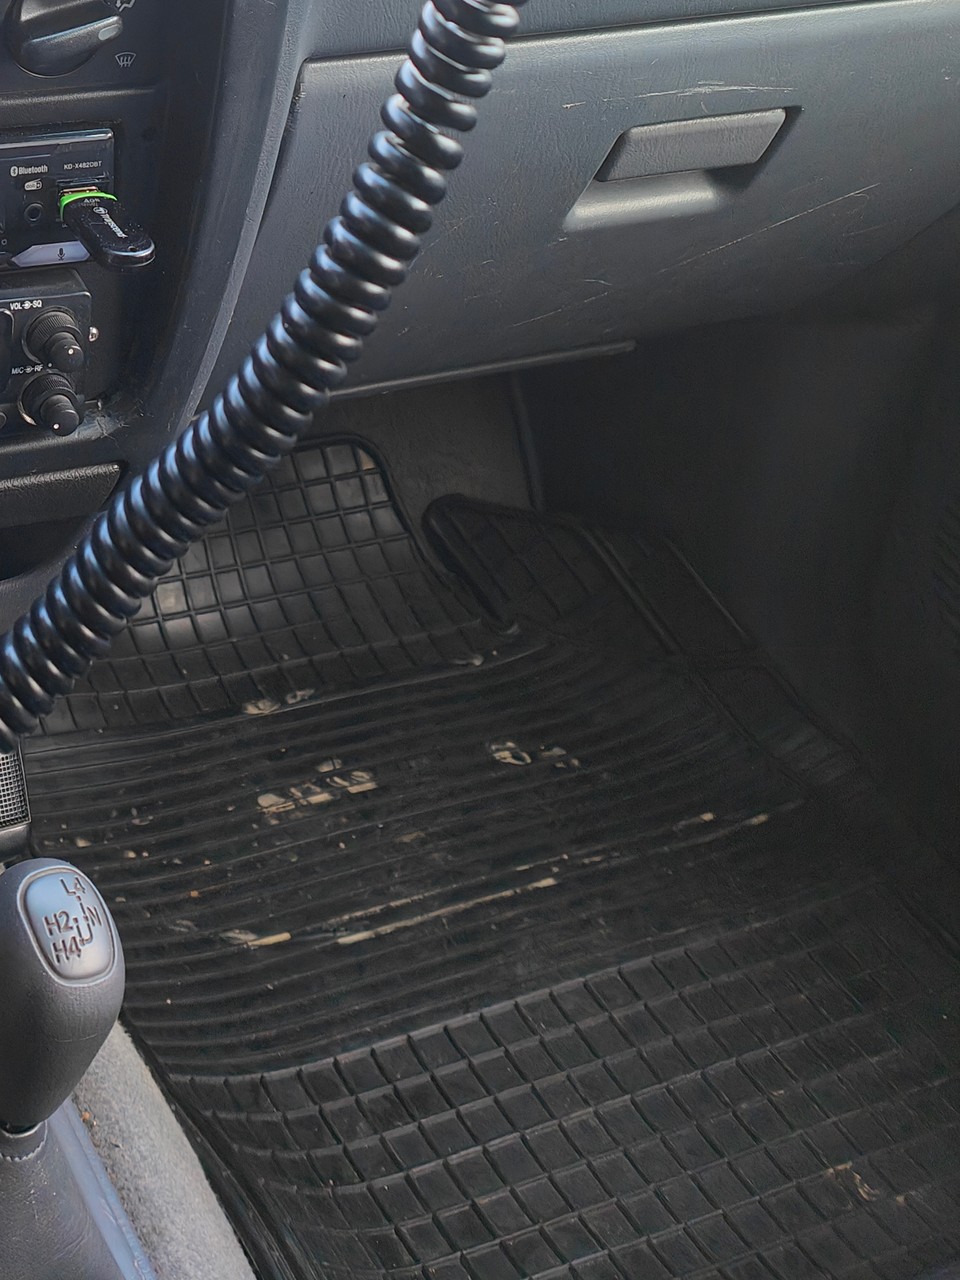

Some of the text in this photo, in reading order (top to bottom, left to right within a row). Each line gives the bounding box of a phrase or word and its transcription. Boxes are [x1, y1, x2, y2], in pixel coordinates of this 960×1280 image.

[18, 164, 48, 175] Bluetooth
[10, 300, 42, 311] VOL SQ
[11, 367, 24, 375] MIC
[59, 876, 86, 896] L4
[43, 910, 73, 936] H2
[86, 906, 102, 927] N
[52, 935, 82, 963] H4
